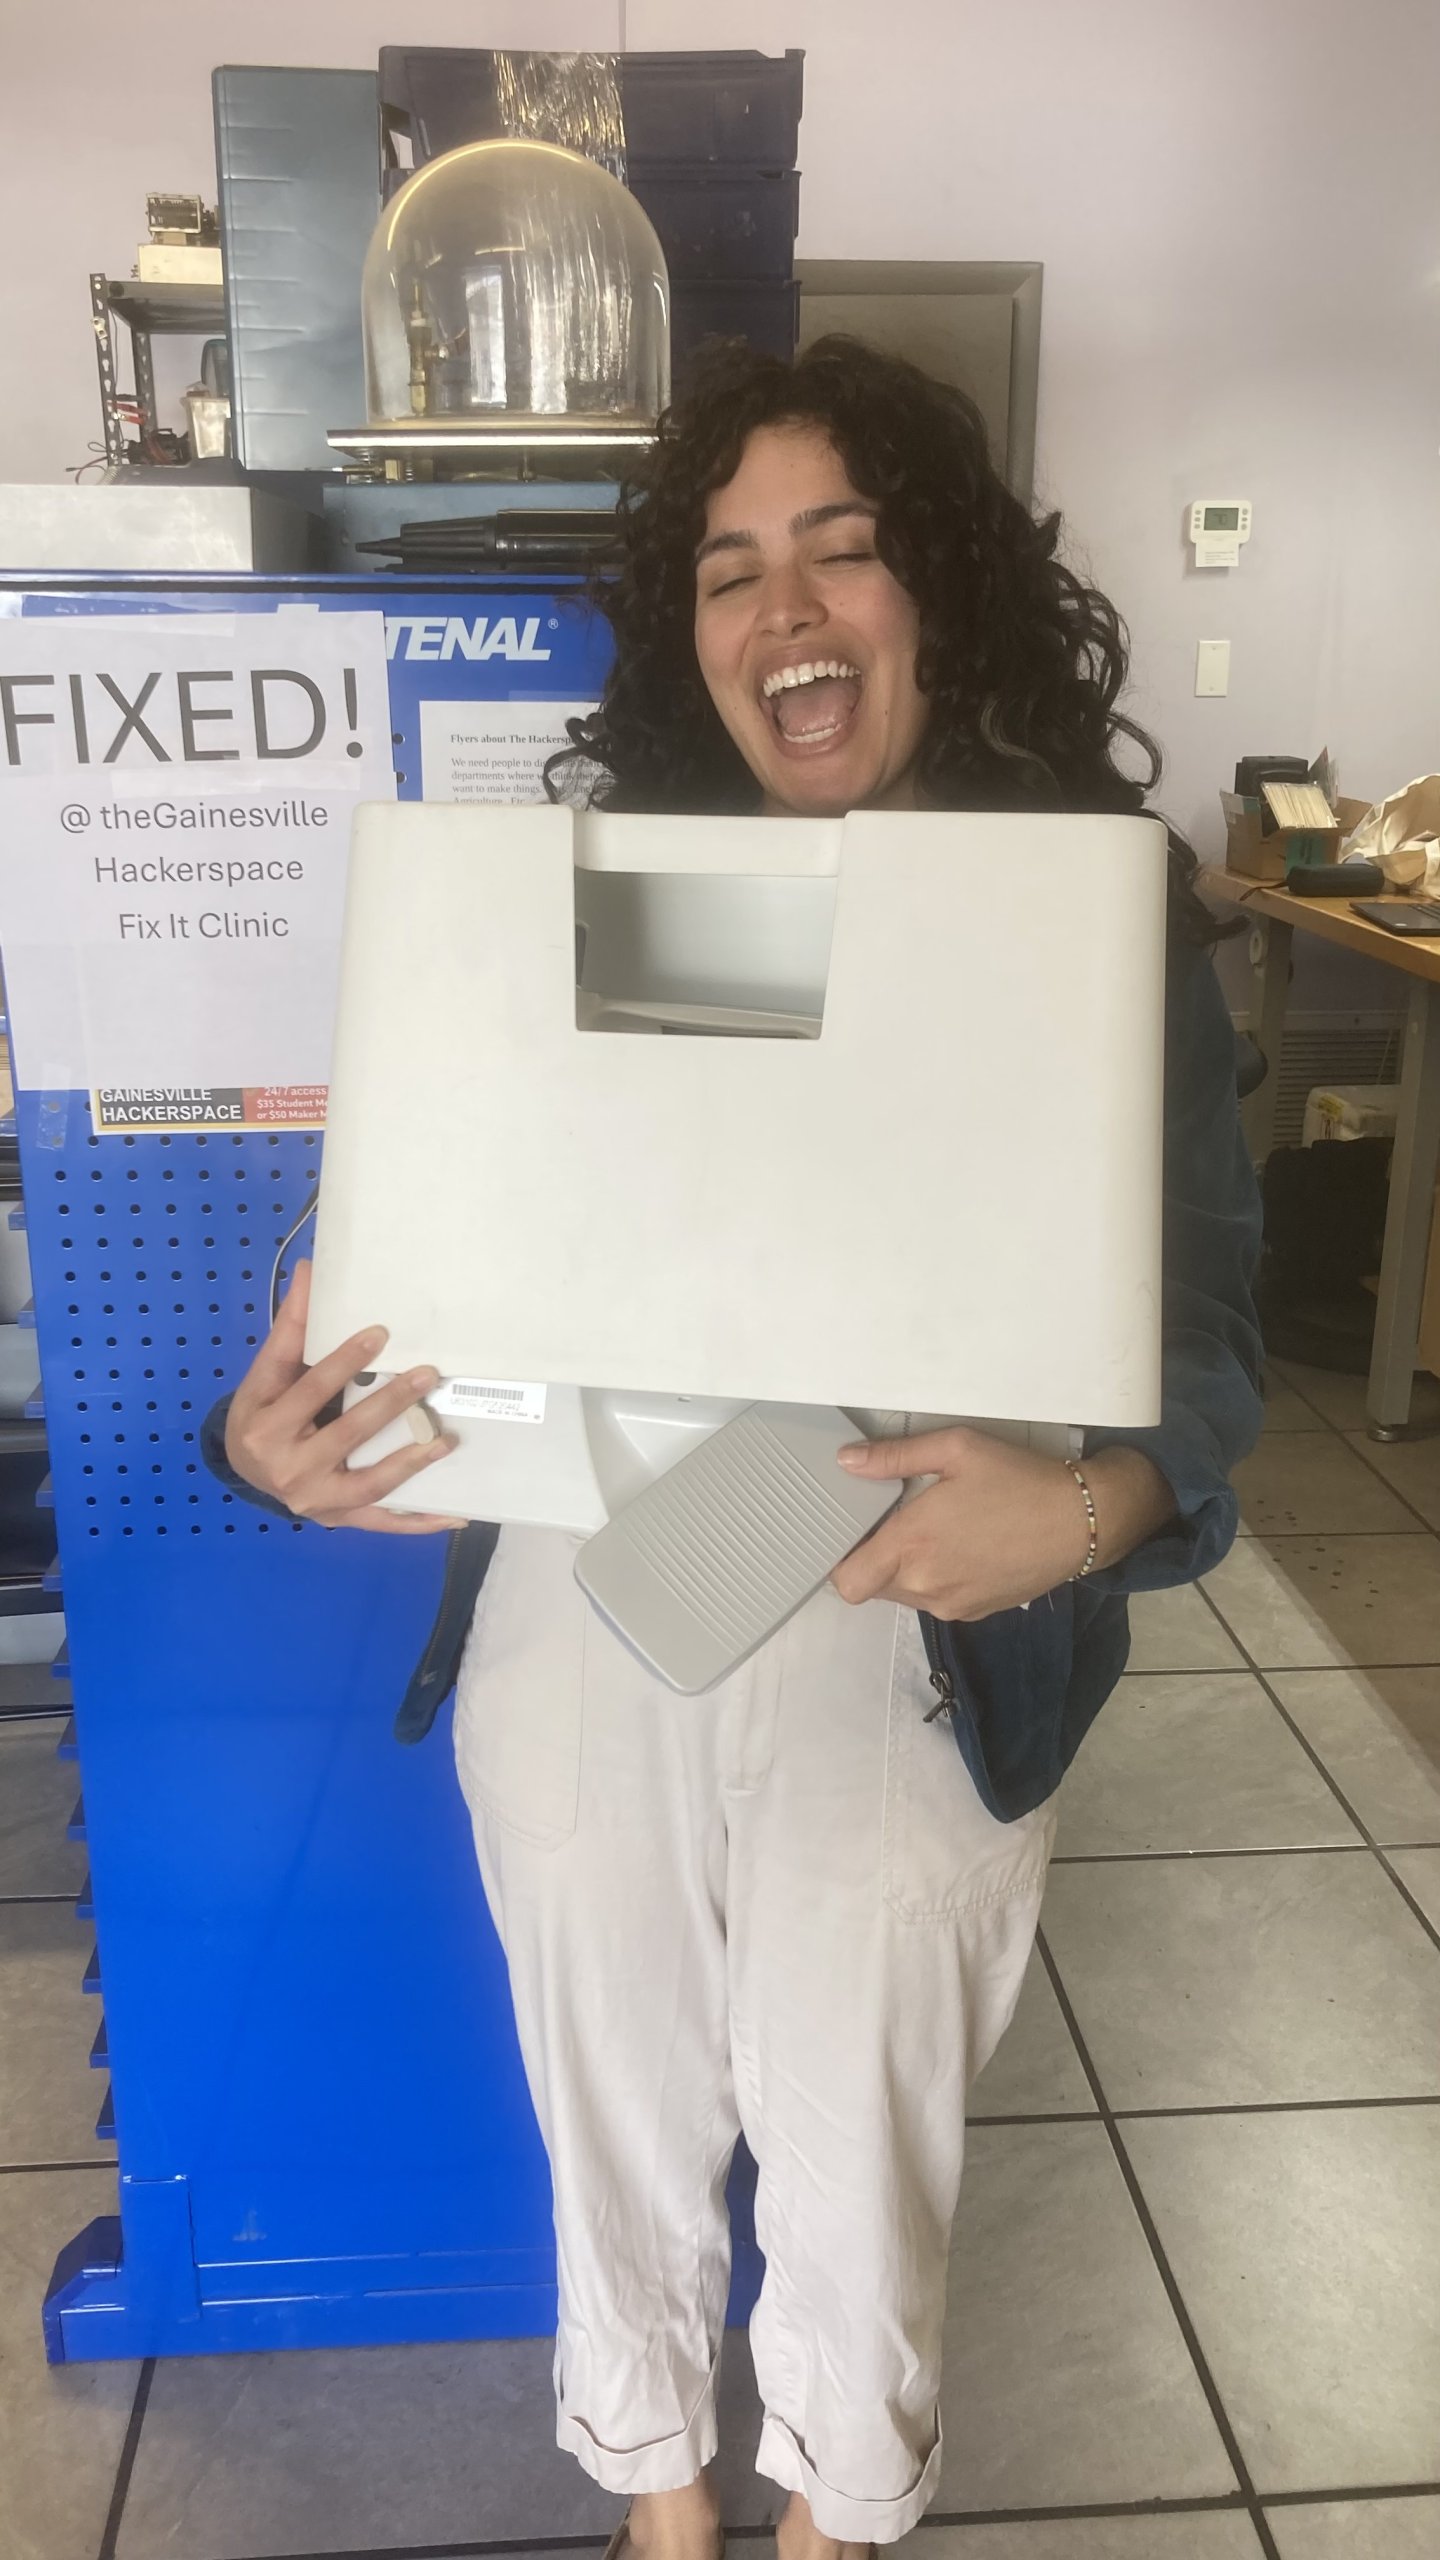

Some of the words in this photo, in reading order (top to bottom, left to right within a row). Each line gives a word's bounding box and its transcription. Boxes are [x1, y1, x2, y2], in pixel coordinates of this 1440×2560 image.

[385, 617, 551, 660] TENAL
[0, 668, 363, 766] FIXED!
[450, 734, 479, 745] Flyers
[481, 734, 506, 743] about
[509, 735, 527, 744] The
[528, 735, 574, 745] Hackersp
[451, 758, 466, 767] We
[468, 758, 489, 767] need
[491, 759, 520, 769] people
[523, 759, 532, 767] to
[451, 770, 505, 782] departments
[508, 772, 535, 781] where
[452, 785, 473, 793] want
[476, 785, 485, 793] to
[487, 785, 511, 794] make
[100, 800, 329, 829] theGainesville
[94, 857, 304, 887] Hackerspace
[119, 913, 162, 939] Fix
[170, 913, 189, 938] It
[198, 912, 289, 938] Clinic
[100, 1088, 213, 1102] GAINESVILLE
[291, 1088, 327, 1096] access
[257, 1099, 275, 1109] $35
[276, 1099, 314, 1107] Student
[101, 1104, 242, 1121] HACKERSPACE
[269, 1110, 287, 1120] $50
[289, 1110, 318, 1118] Maker
